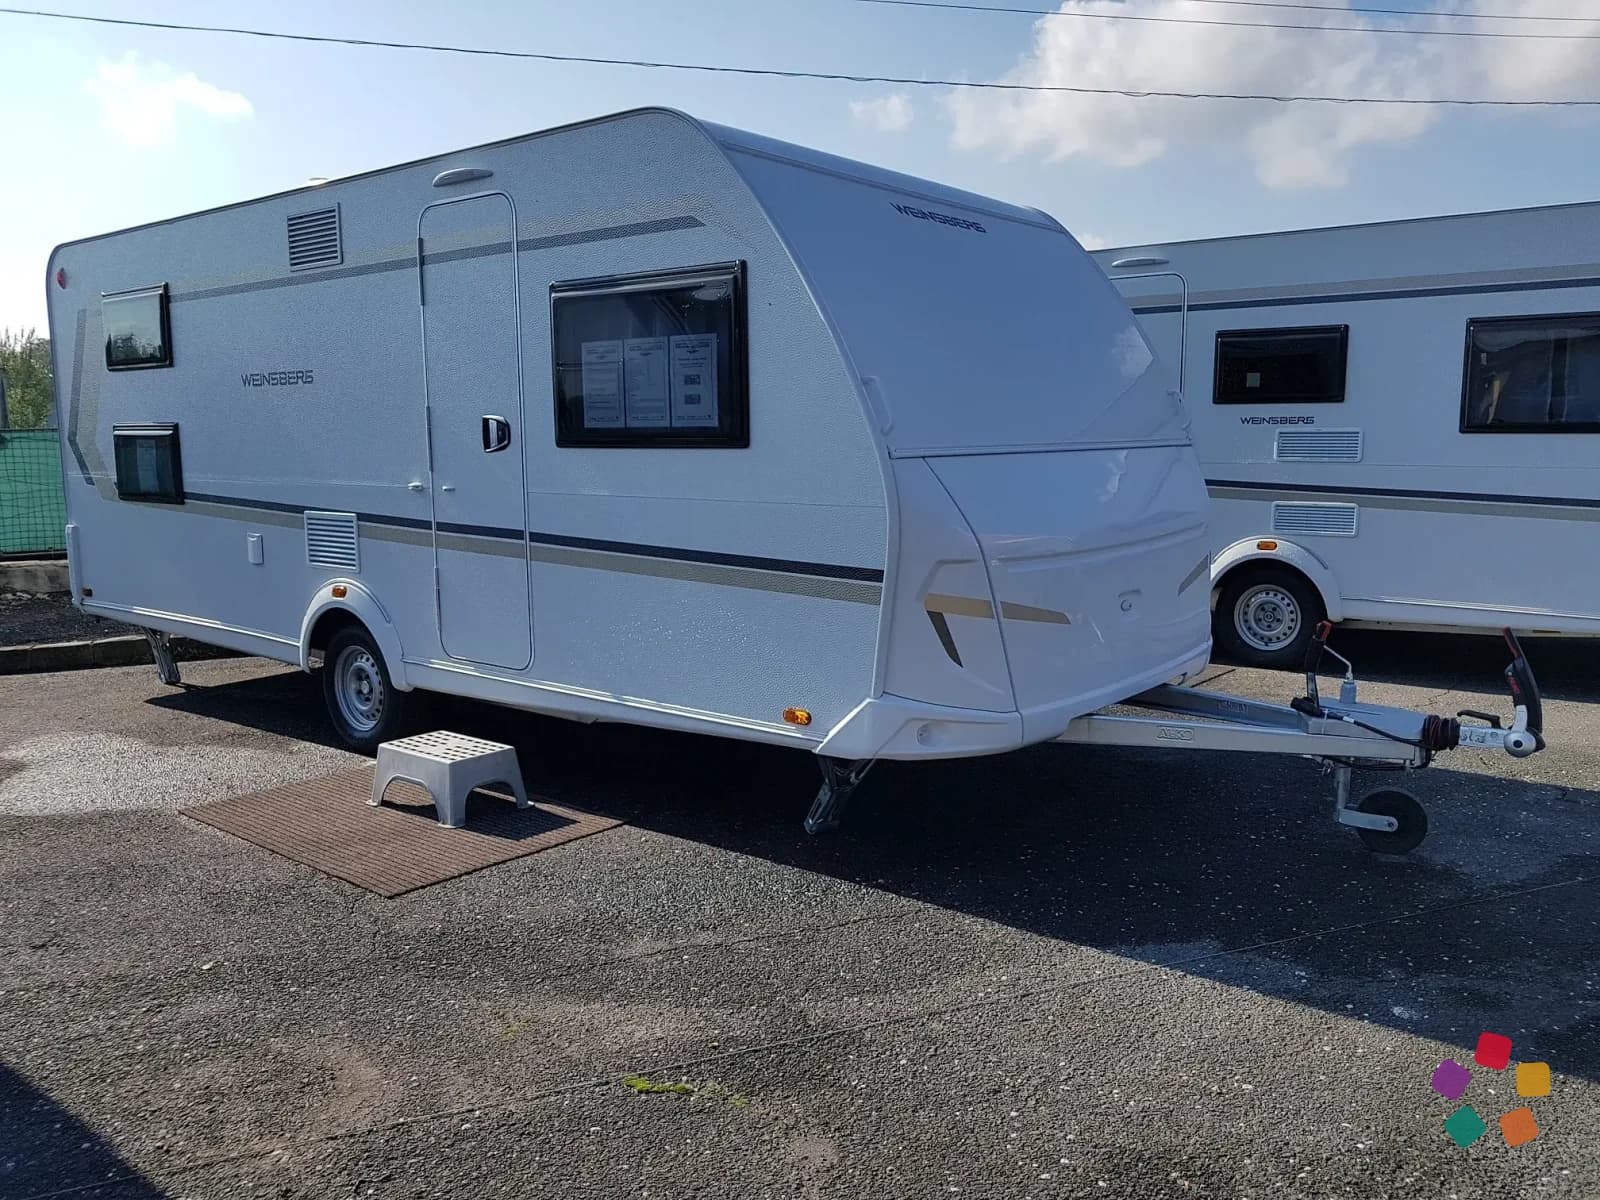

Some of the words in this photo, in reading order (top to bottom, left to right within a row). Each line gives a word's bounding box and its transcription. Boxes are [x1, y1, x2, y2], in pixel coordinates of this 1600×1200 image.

[889, 201, 987, 233] WEINSBERG
[240, 369, 314, 387] WEINSBERG
[1240, 416, 1315, 425] WEINSBERG
